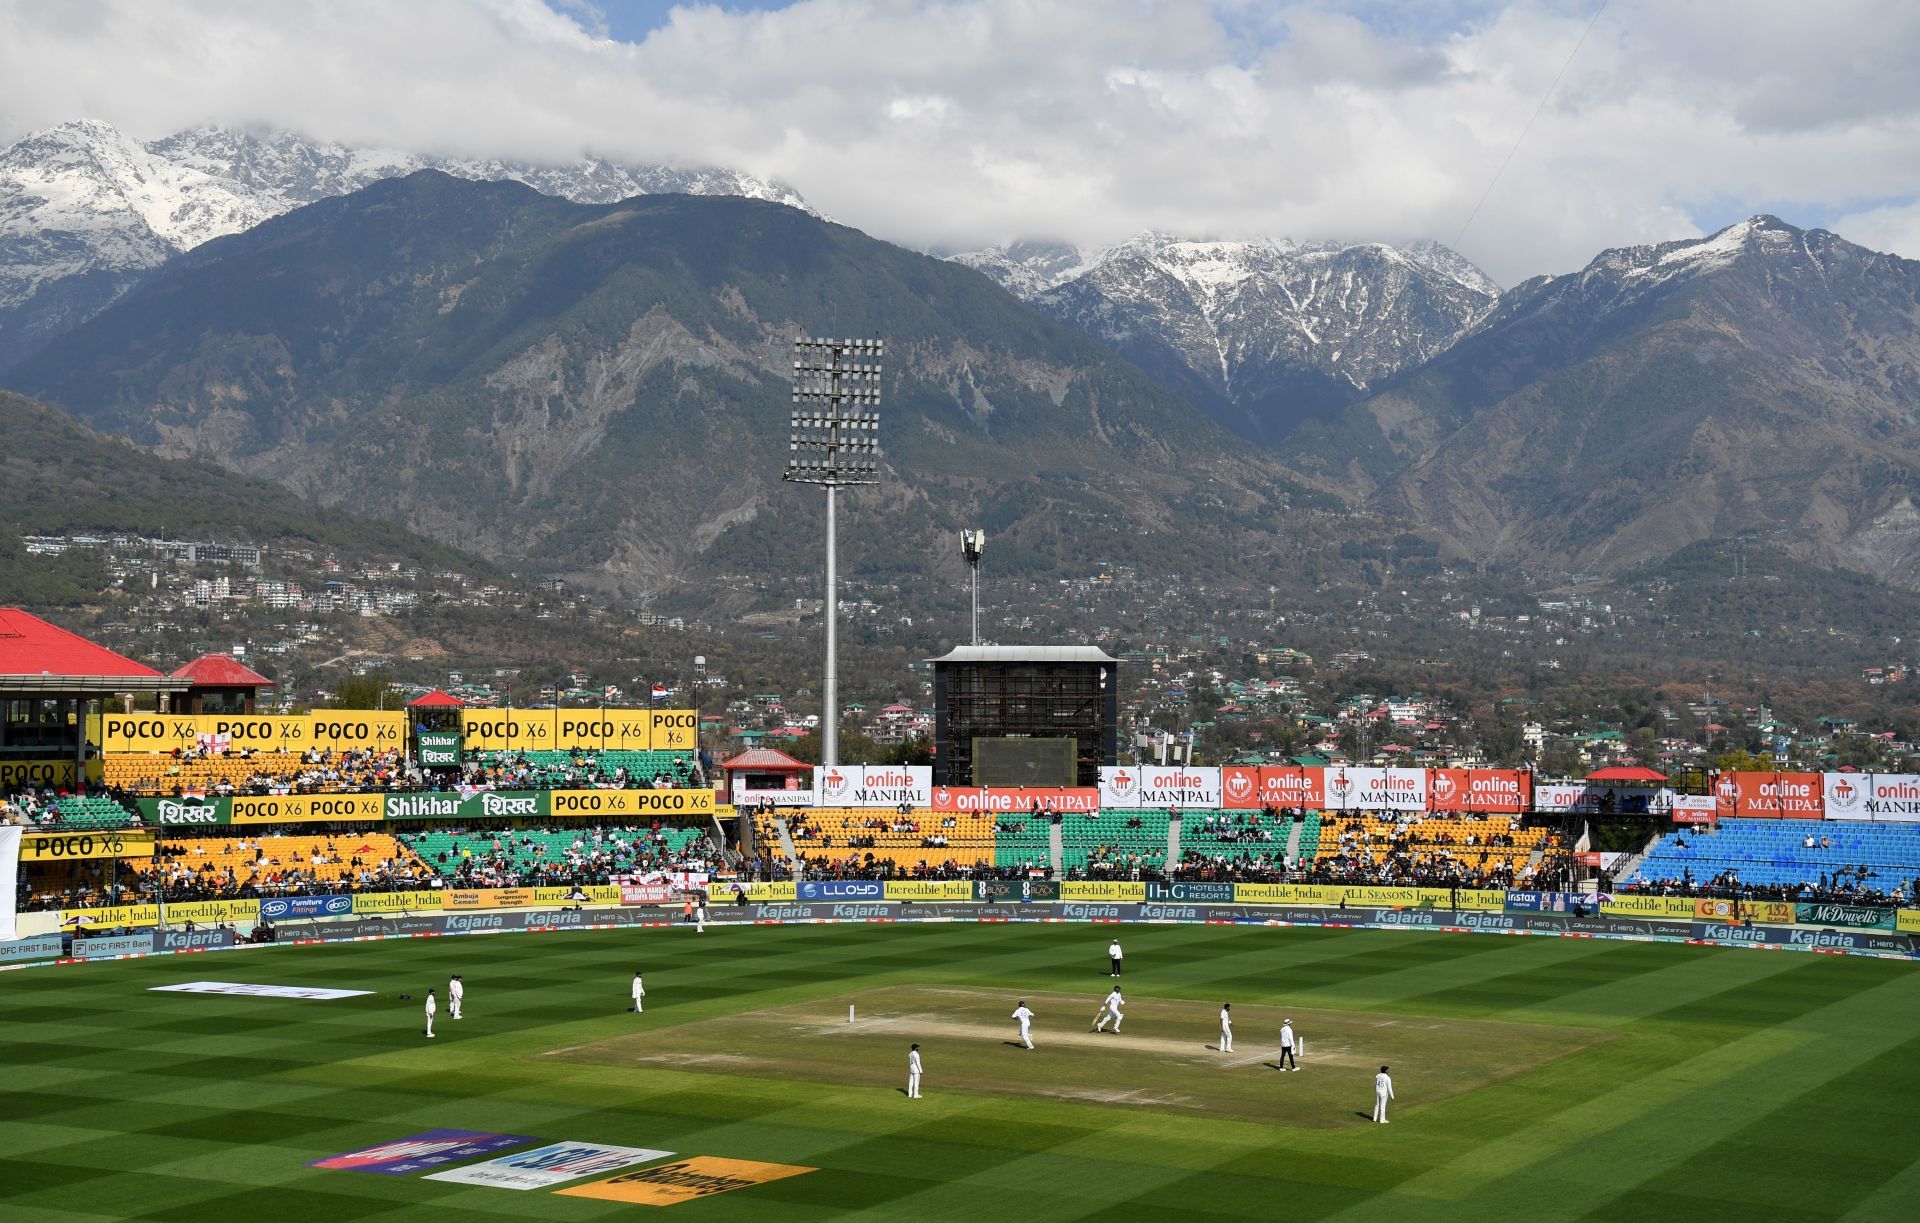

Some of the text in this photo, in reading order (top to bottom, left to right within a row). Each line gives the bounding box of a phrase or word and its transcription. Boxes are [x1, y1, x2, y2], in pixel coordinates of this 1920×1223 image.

[108, 720, 195, 738] POCO X6
[654, 715, 696, 728] POCO
[217, 722, 301, 738] POCO X6
[315, 723, 396, 739] POCO X6
[467, 722, 546, 737] POCO X6
[563, 722, 641, 737] POCO X6
[668, 731, 683, 743] X6
[421, 736, 456, 746] Shikhar
[422, 750, 455, 762] शिखर
[1, 764, 55, 782] POCO
[866, 771, 913, 787] online
[1154, 772, 1201, 788] online
[1268, 774, 1312, 789] online
[1371, 776, 1415, 790] online
[1473, 777, 1518, 792] online
[1760, 780, 1809, 797] online
[555, 796, 600, 810] POCO
[607, 796, 625, 808] X6
[639, 795, 684, 809] POCO
[854, 790, 925, 801] MANIPAL
[957, 791, 1096, 810] online MANIPAL
[1143, 790, 1214, 802] MANIPAL
[1258, 791, 1323, 802] MANIPAL
[1360, 792, 1426, 803] MANIPAL
[1462, 794, 1529, 806] MANIPAL
[1554, 790, 1600, 805] online
[157, 799, 218, 824] शिखर
[234, 801, 378, 817] POCO X6 POCO X6
[387, 796, 462, 817] Shikhar
[482, 793, 537, 815] शिखर
[1748, 798, 1823, 811] MANIPAL
[36, 836, 123, 857] POCO X6
[824, 884, 878, 895] LLOYD
[886, 882, 940, 894] Incredible
[979, 882, 986, 895] 8
[1023, 882, 1030, 895] 8
[1060, 883, 1114, 896] Incredible
[1236, 885, 1291, 897] Incredible
[1343, 888, 1413, 900] ALL SEASONS
[355, 895, 412, 908] Incredible
[1508, 892, 1535, 902] instax
[168, 903, 226, 918] Incredible
[757, 905, 812, 920] Kajaria
[833, 905, 889, 918] Kajaria
[1063, 905, 1119, 918] Kajaria
[1140, 905, 1196, 920] Kajaria
[1375, 910, 1432, 925] Kajaria
[1765, 904, 1789, 916] 132
[445, 915, 503, 930] Kajaria
[524, 911, 581, 926] Kajaria
[1455, 913, 1513, 928] Kajaria
[164, 931, 223, 948] Kajaria
[1704, 925, 1766, 941] Kajaria
[1790, 930, 1854, 947] Kajaria
[19, 945, 40, 953] FIRST
[43, 943, 61, 951] Bank
[88, 940, 152, 951] IDFC FIRST Bank
